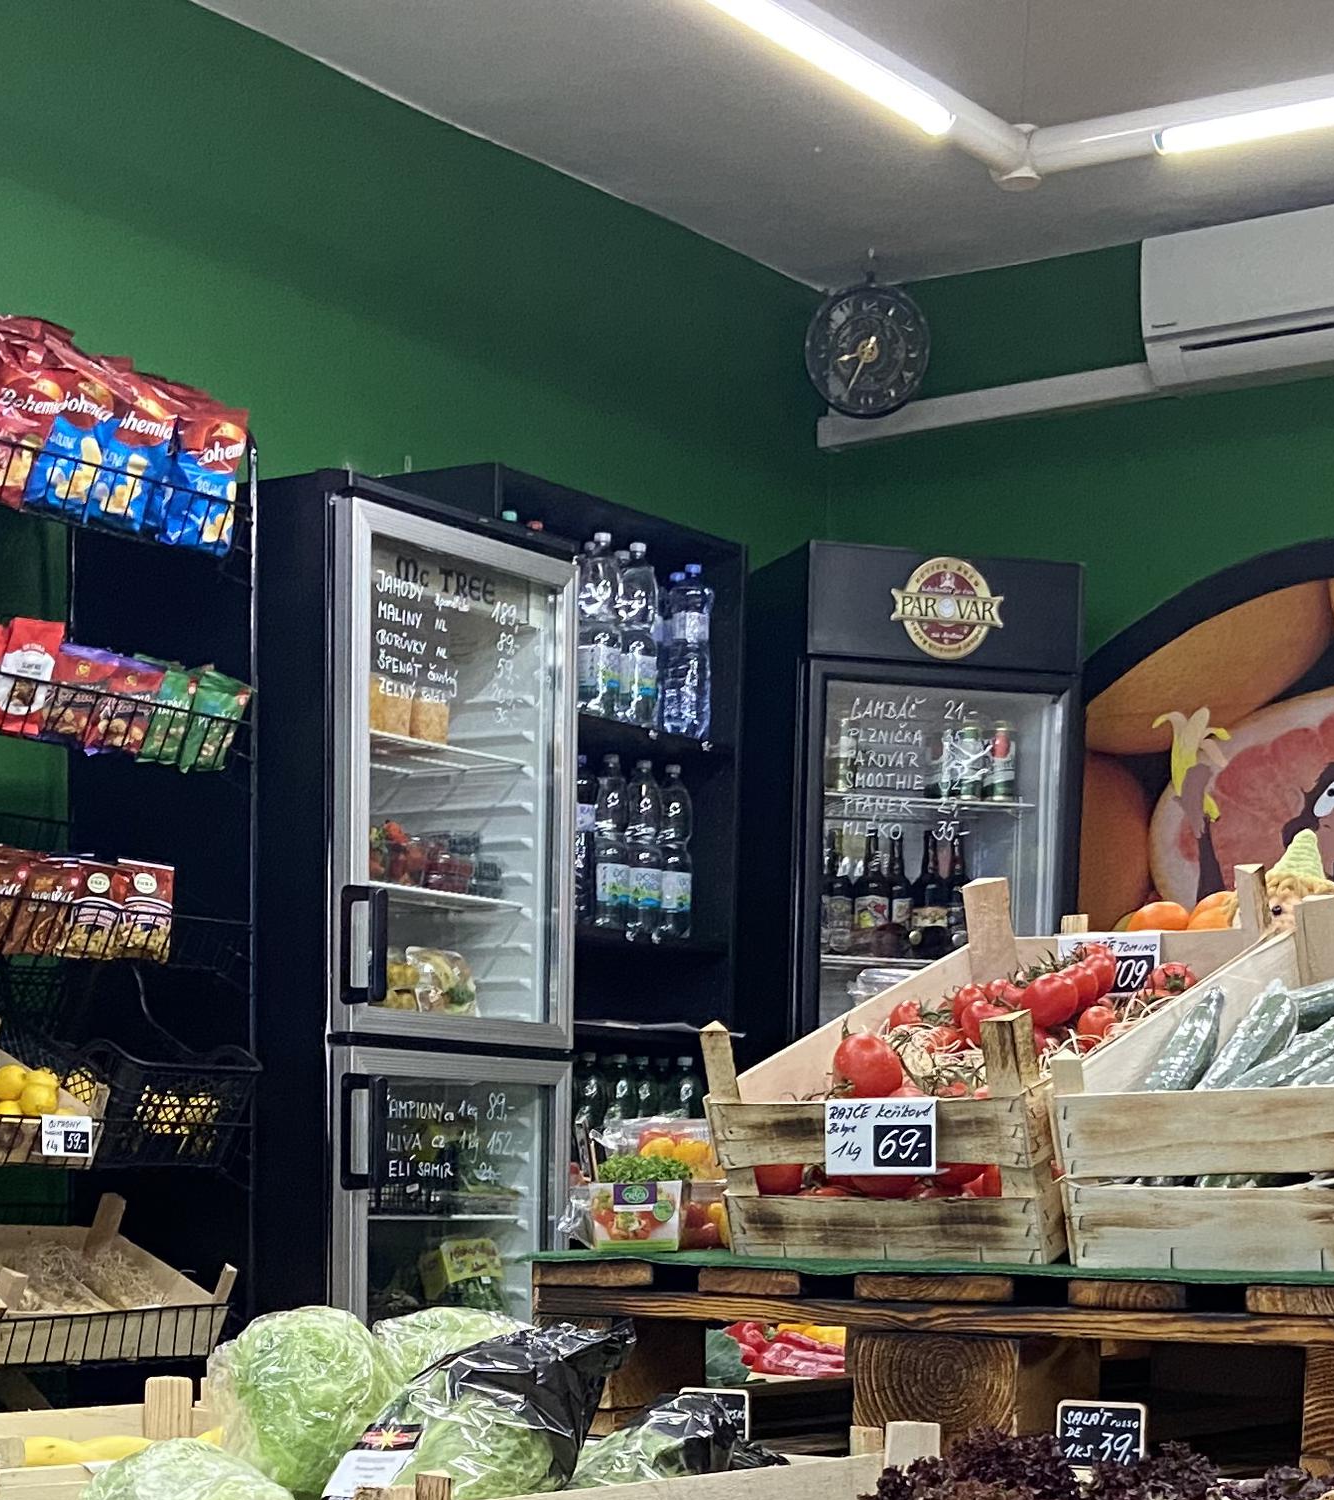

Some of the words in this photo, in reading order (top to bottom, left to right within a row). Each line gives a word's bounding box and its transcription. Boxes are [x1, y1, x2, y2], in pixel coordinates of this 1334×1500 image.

[376, 569, 424, 602] JAHODY
[377, 601, 423, 629] MALINY
[375, 628, 427, 655] BORŮVKY
[377, 648, 423, 678] ŠPENÁT
[846, 750, 919, 768] PAROVAR
[845, 772, 925, 790] SMOOTHIE
[1118, 941, 1157, 953] TOMINO
[387, 1095, 445, 1122] AMPIONY
[829, 1103, 872, 1120] RAJČE
[878, 1128, 926, 1162] 69,-
[388, 1155, 416, 1178] ELÍ
[1063, 1408, 1113, 1427] SALÁT
